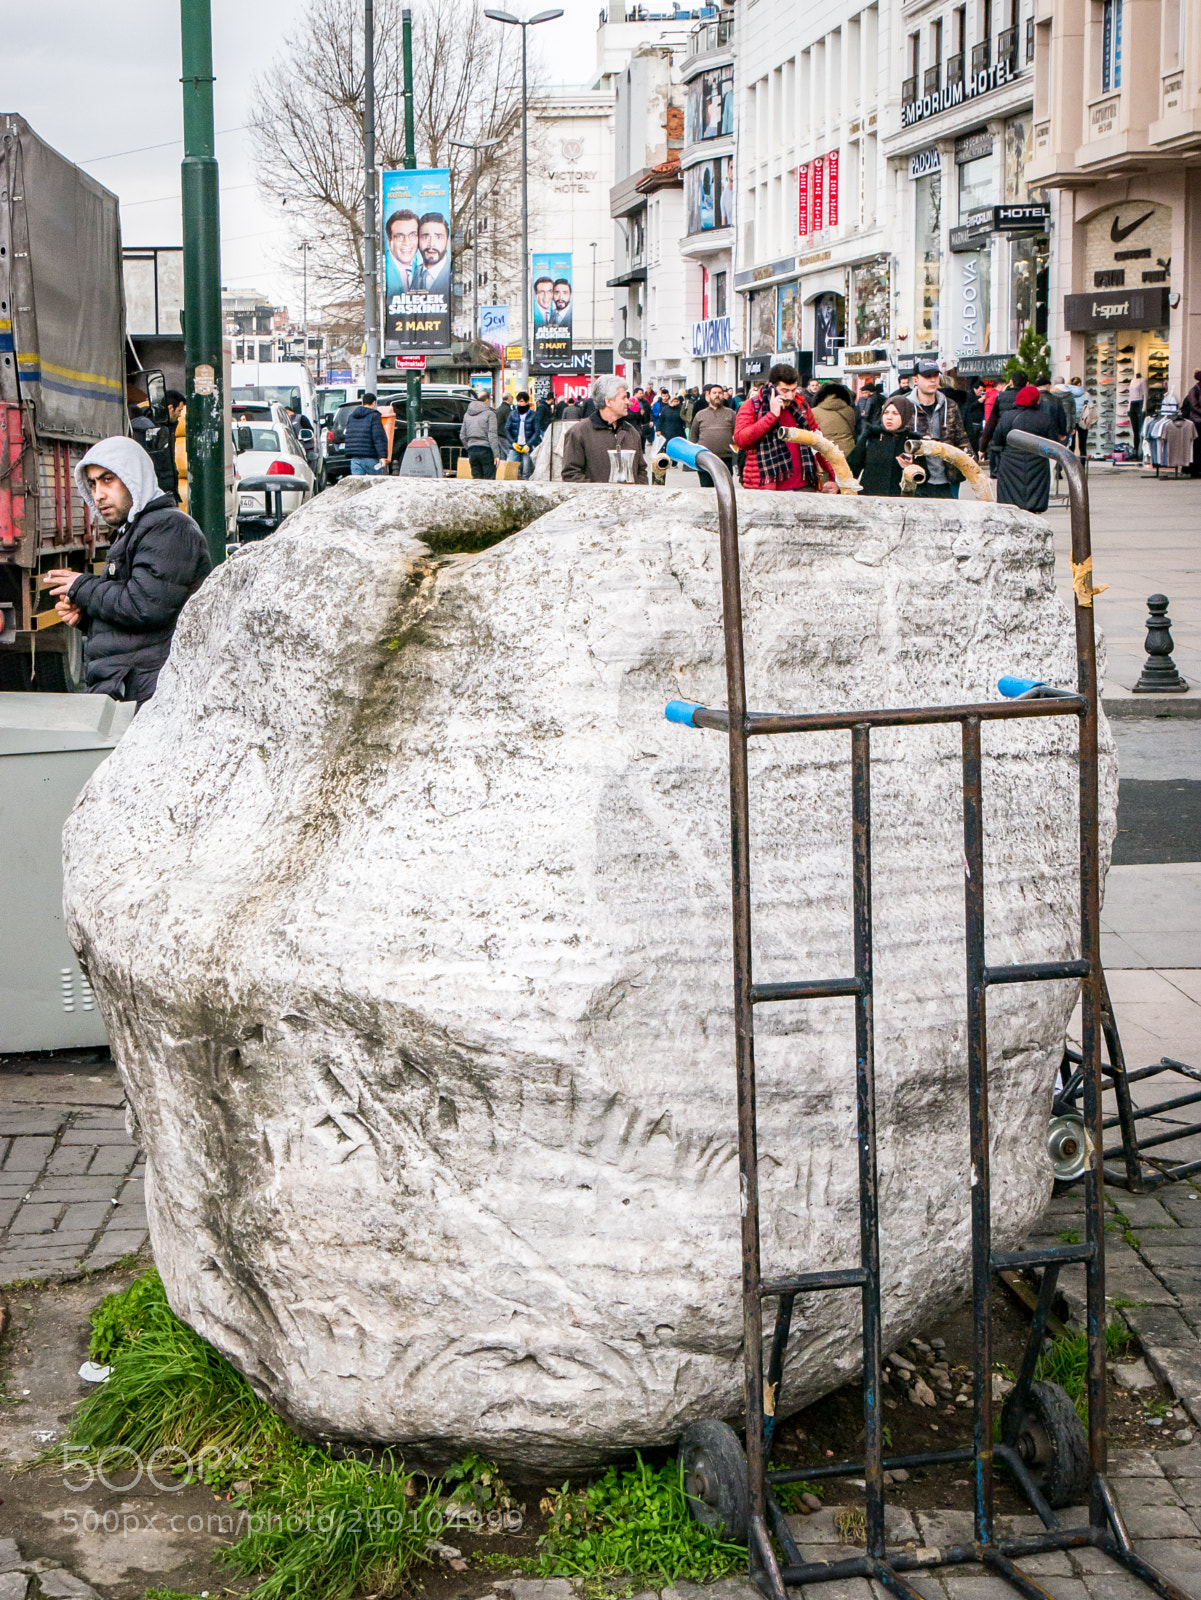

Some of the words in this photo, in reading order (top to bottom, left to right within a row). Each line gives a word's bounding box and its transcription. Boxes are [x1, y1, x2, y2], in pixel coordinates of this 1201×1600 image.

[901, 80, 963, 129] EMPORIUM
[969, 58, 1014, 98] HOTEL
[548, 171, 597, 180] VICTORY
[554, 184, 590, 193] HOTEL
[1000, 207, 1051, 218] HOTEL
[963, 259, 977, 346] PADOVA
[395, 321, 403, 332] 2
[405, 320, 442, 331] MART
